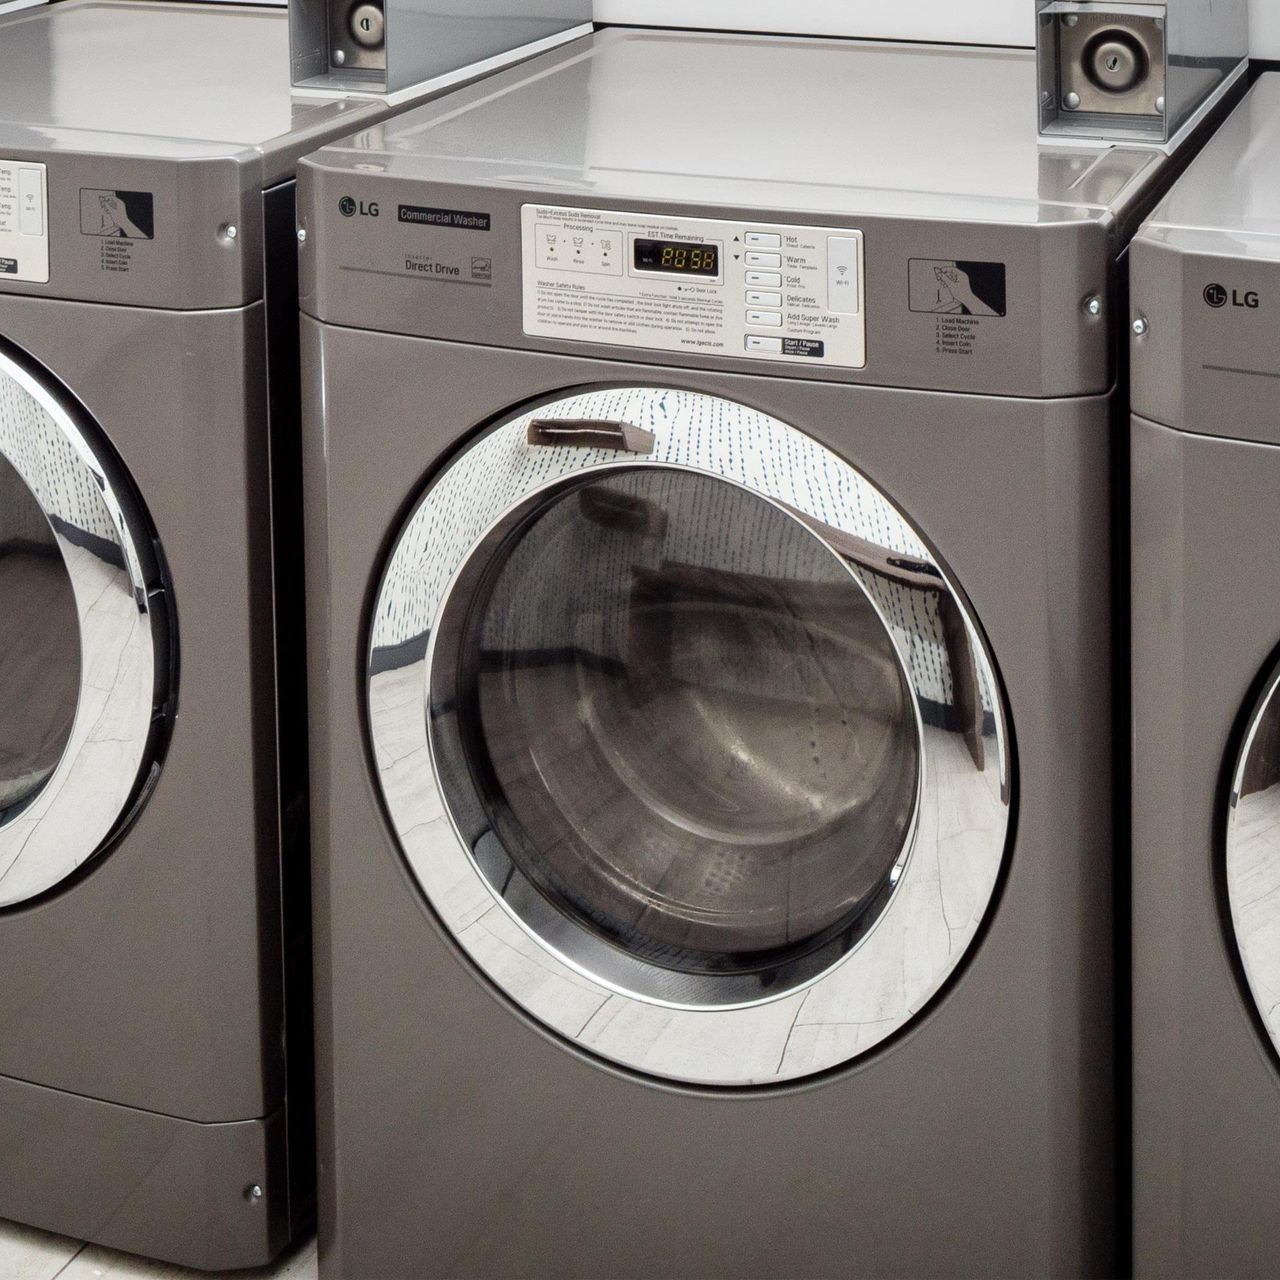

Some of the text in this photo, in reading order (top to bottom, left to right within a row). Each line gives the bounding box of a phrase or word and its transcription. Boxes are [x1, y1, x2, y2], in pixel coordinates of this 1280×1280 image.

[360, 202, 379, 216] LG
[400, 209, 488, 227] Commercial Washer
[563, 223, 593, 232] Processing
[674, 234, 704, 242] Remaining
[405, 260, 433, 273] Direct
[435, 263, 460, 276] Drive
[787, 295, 816, 304] Delicates
[1232, 290, 1259, 308] LG
[801, 314, 819, 322] Super
[803, 340, 819, 348] Pause
